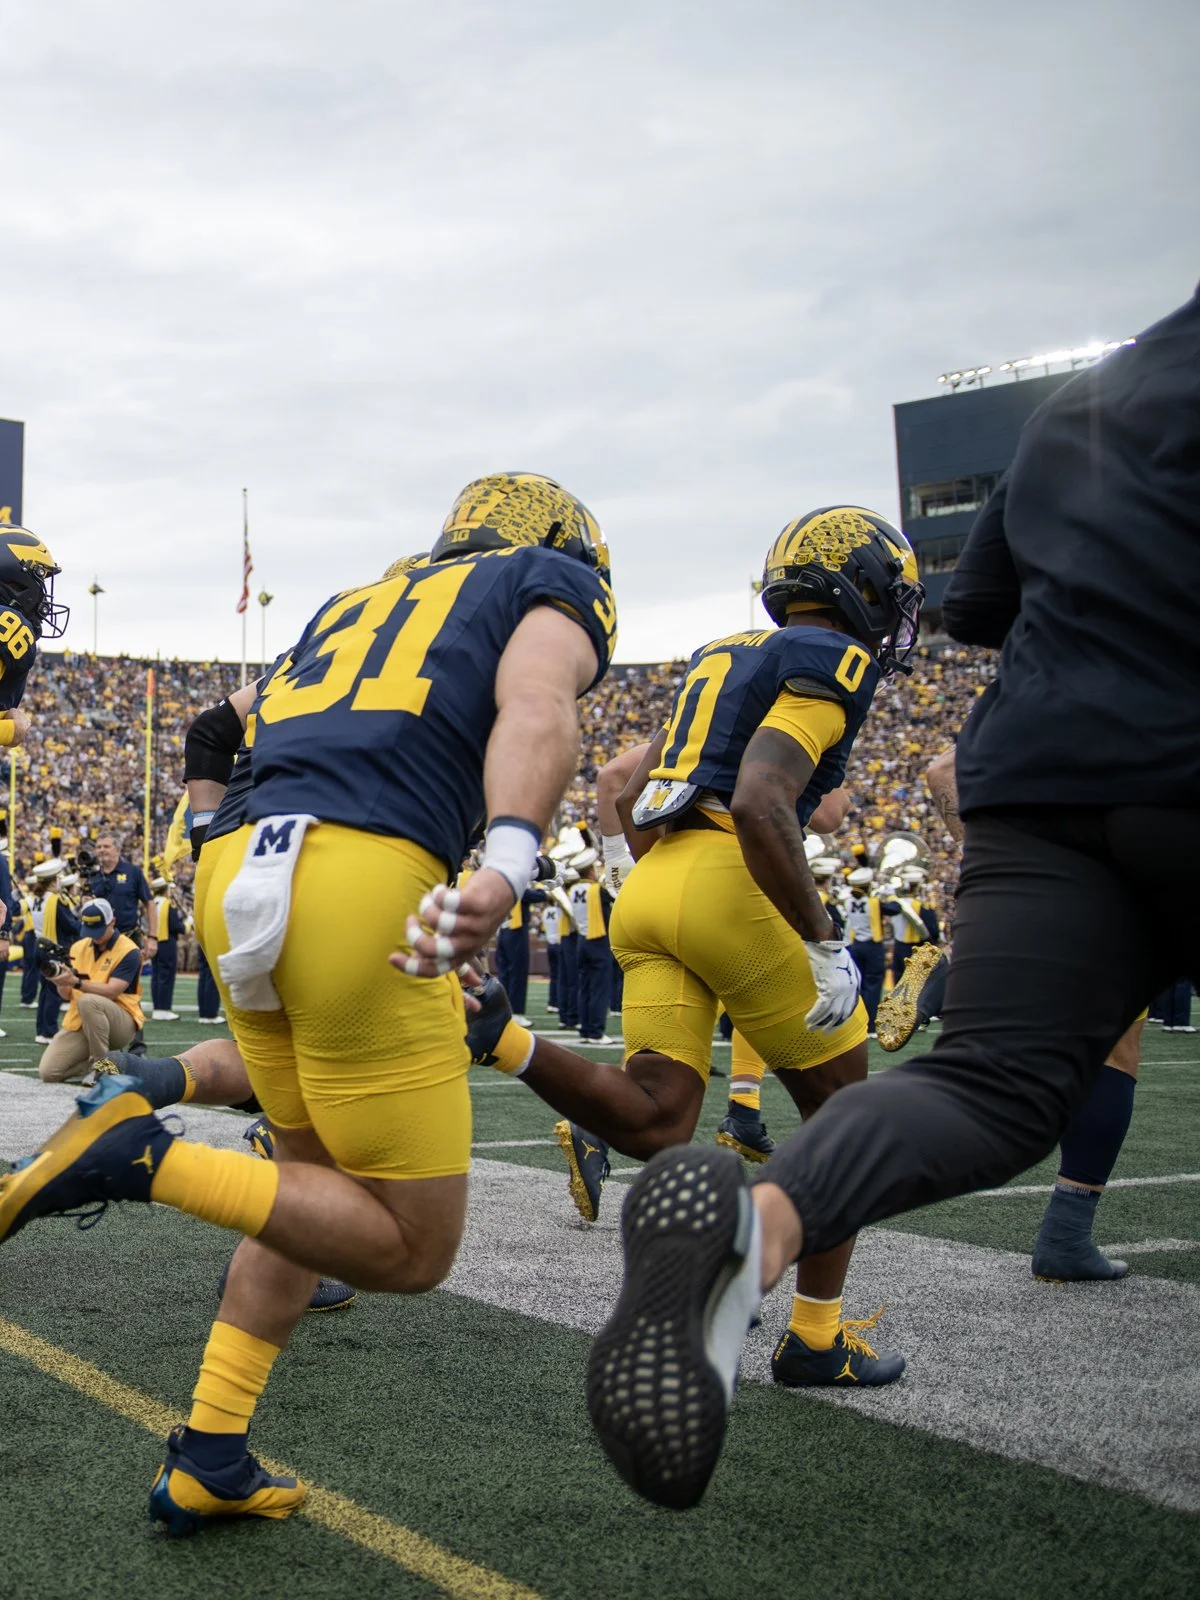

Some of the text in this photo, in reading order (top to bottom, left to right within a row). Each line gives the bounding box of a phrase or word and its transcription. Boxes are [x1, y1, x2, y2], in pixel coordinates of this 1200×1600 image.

[259, 562, 477, 725] 31
[834, 645, 871, 693] 0
[649, 652, 733, 782] 0
[253, 819, 297, 857] M
[574, 890, 587, 904] M
[851, 901, 867, 914] M
